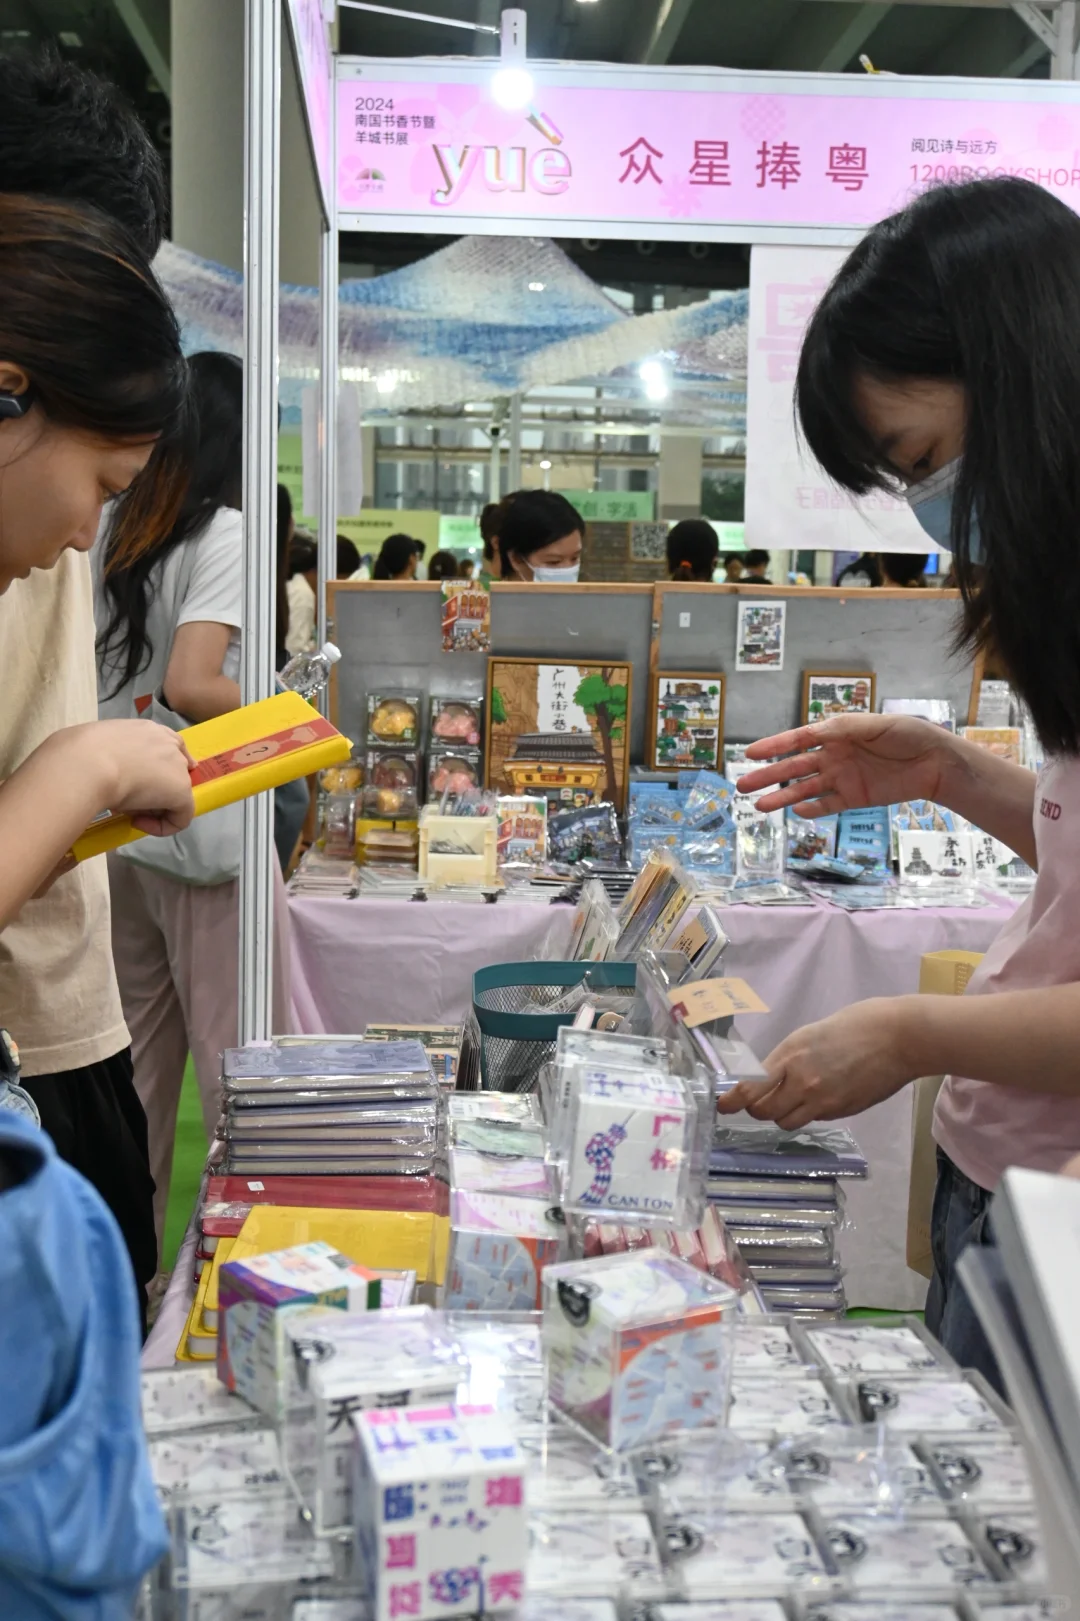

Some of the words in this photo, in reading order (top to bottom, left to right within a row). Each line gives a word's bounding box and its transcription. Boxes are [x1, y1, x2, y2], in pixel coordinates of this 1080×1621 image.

[355, 97, 394, 111] 2024
[355, 114, 436, 129] 南国书香节暨
[355, 131, 408, 145] 羊城书展
[911, 138, 998, 155] 阅见诗与远方
[618, 136, 869, 191] 众星捧粤
[550, 667, 569, 731] 广州大街小巷
[607, 1194, 674, 1211] CANTON
